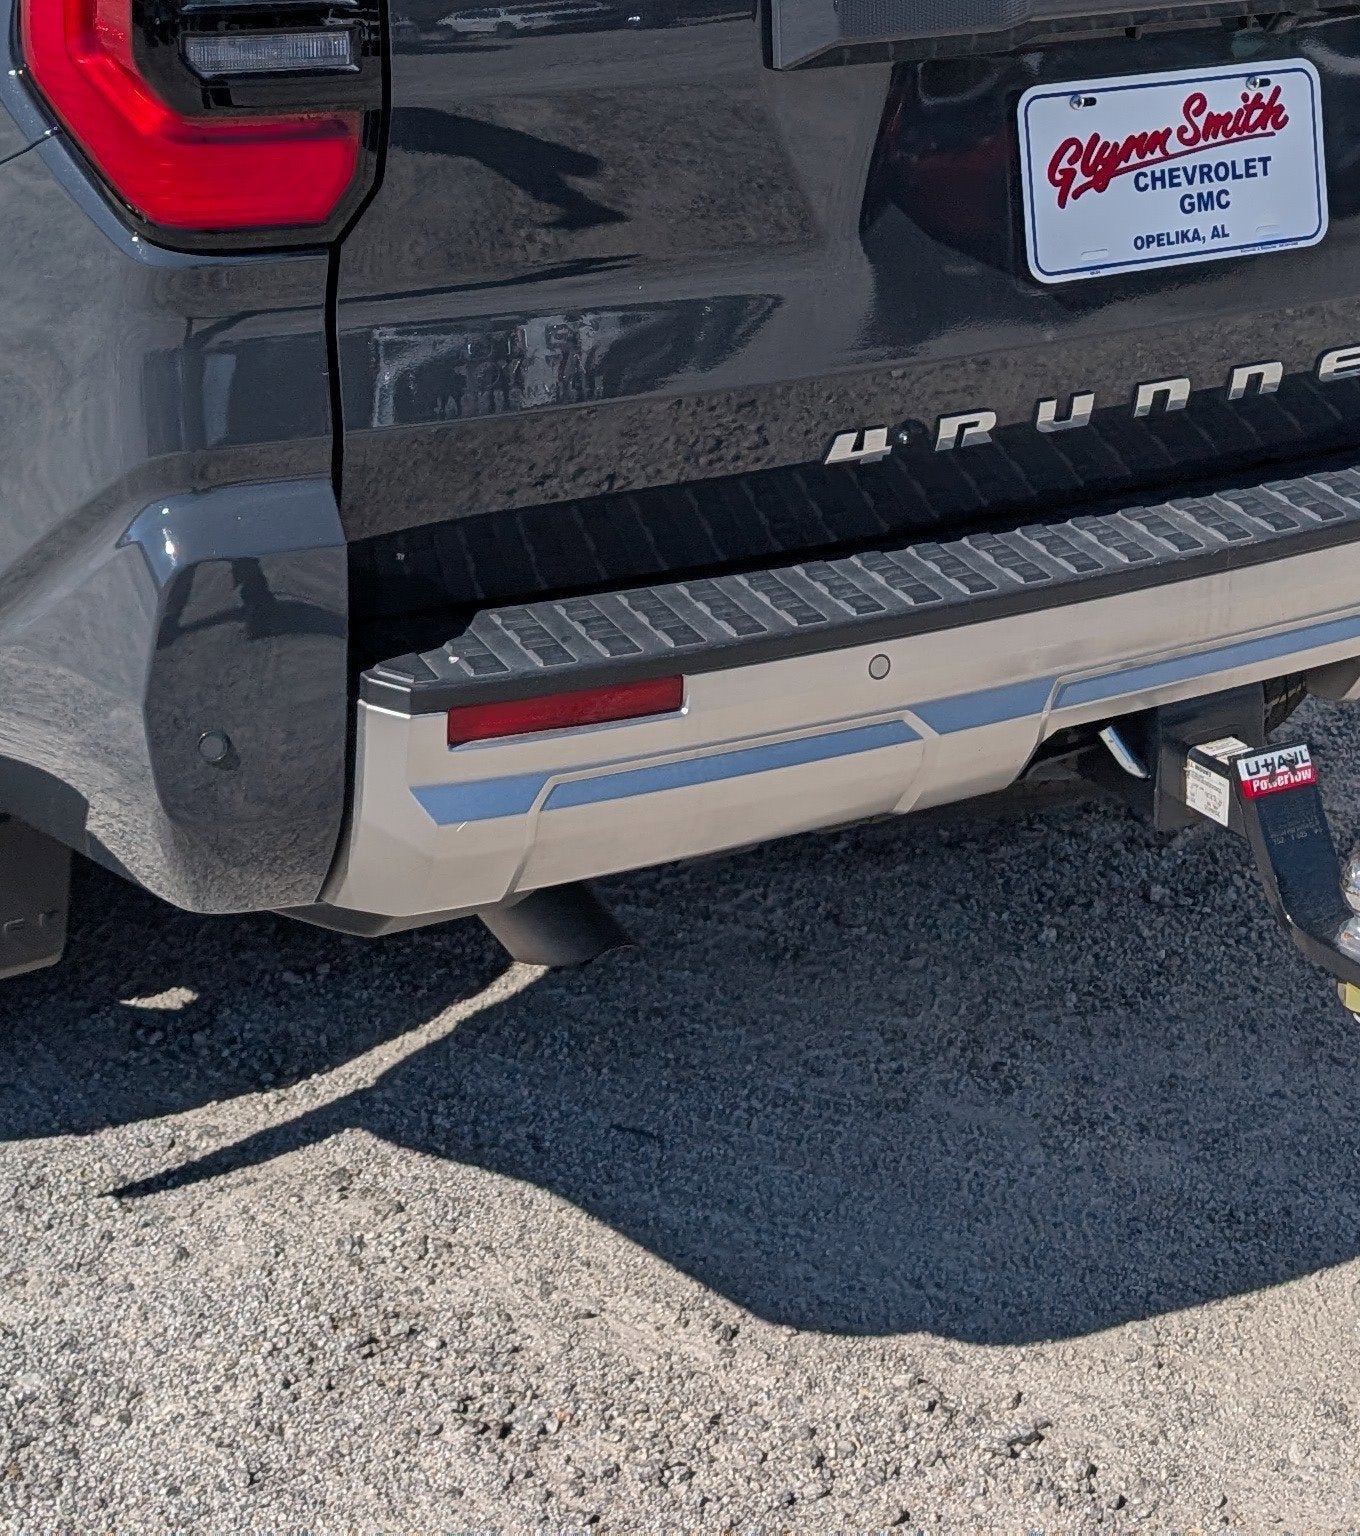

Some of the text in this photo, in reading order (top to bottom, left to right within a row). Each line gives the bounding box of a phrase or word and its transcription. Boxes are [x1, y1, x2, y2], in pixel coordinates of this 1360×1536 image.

[1047, 84, 1290, 210] Glynn Smith
[1133, 155, 1272, 193] CHEVROLET
[1179, 188, 1232, 215] GMC
[1133, 223, 1230, 252] OPELIKA, AL
